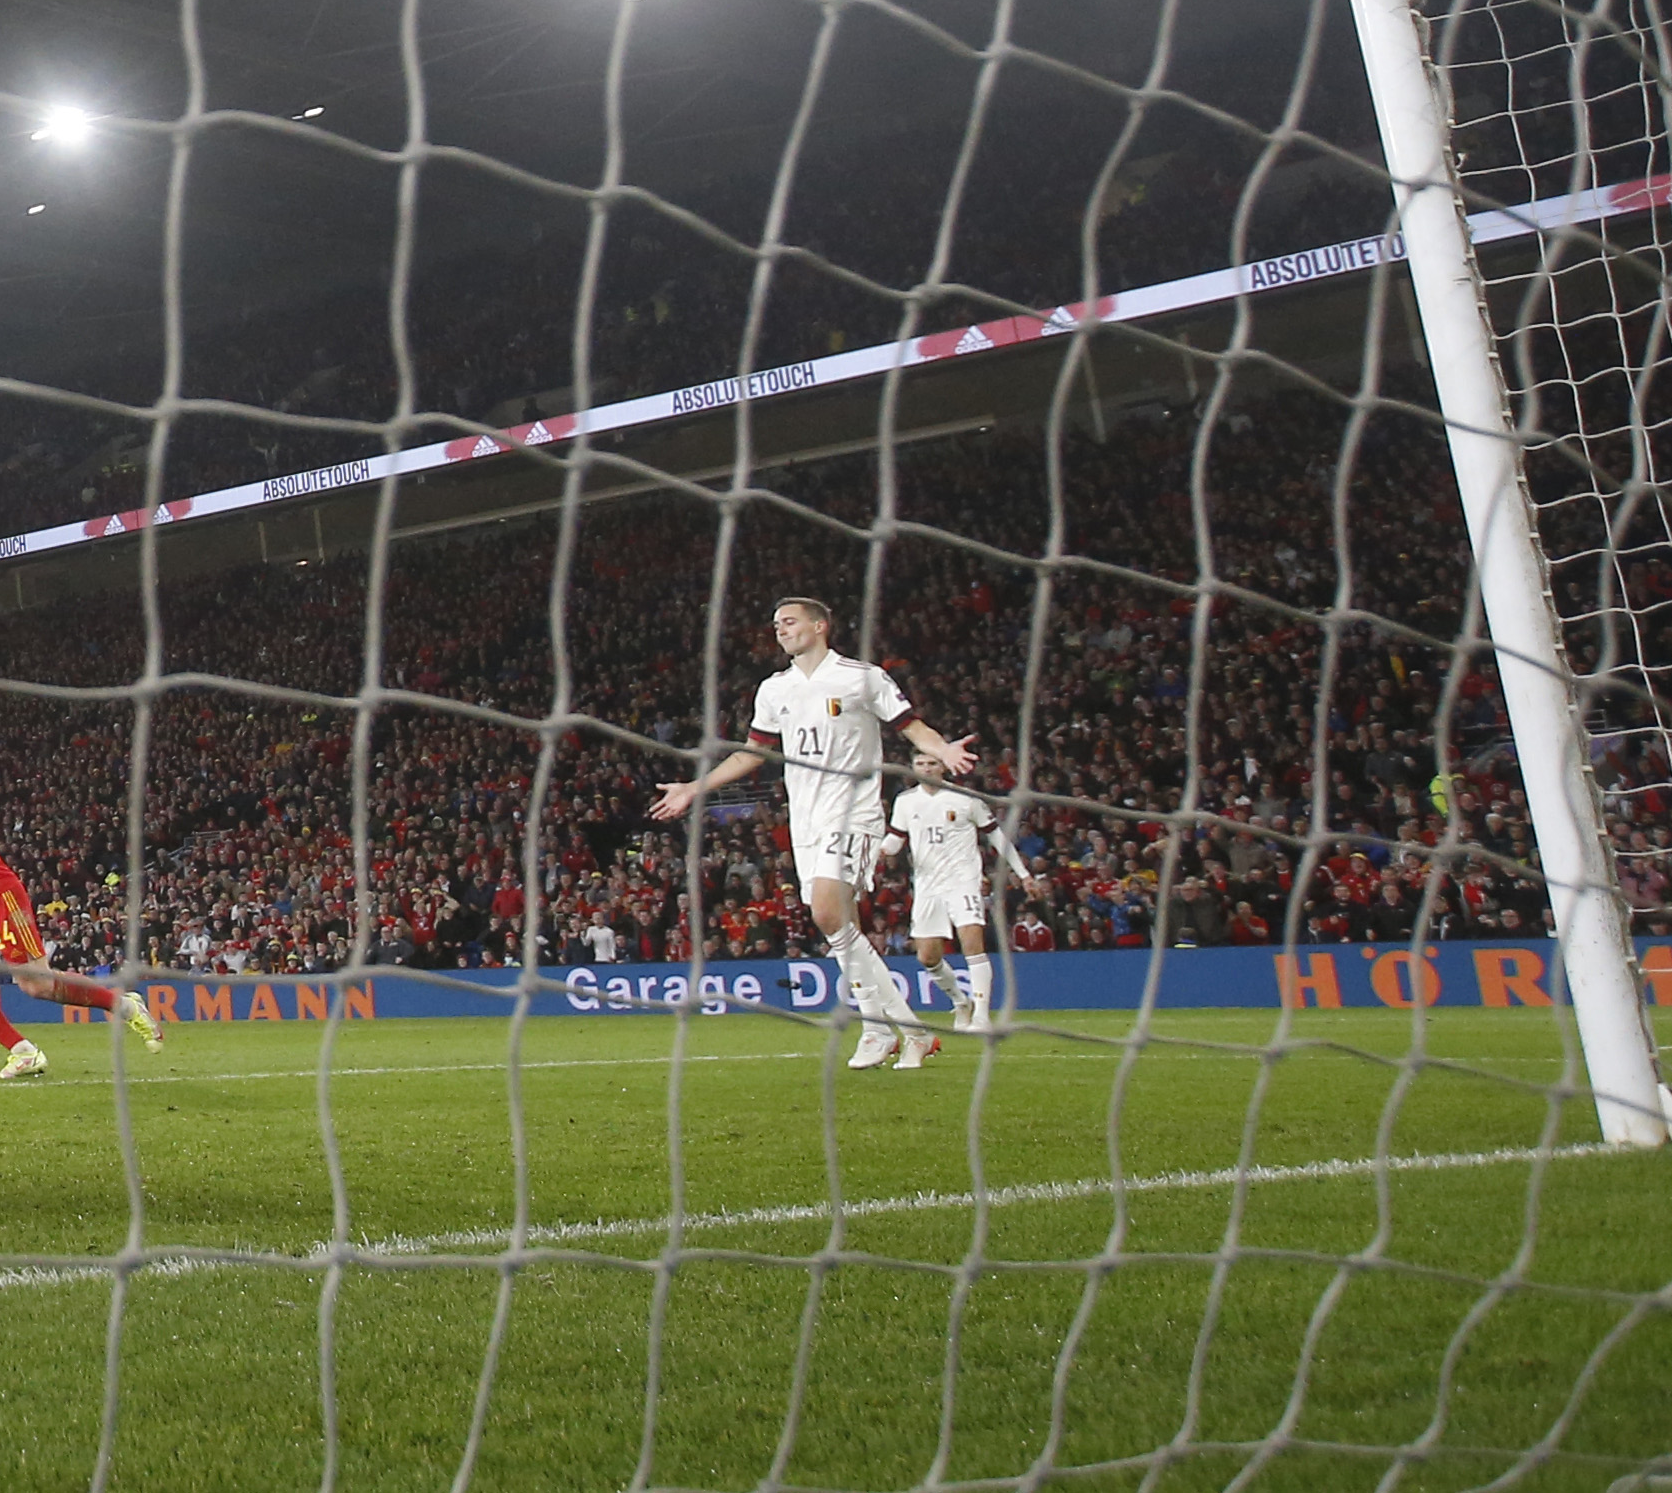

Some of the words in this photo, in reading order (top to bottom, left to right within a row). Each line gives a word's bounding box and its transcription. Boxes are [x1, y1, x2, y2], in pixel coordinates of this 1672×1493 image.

[1251, 234, 1408, 289] ABSOLUTETO
[262, 459, 371, 500] ABSOLUTETOUCH
[796, 727, 824, 755] 21
[826, 832, 855, 858] 21
[927, 827, 944, 844] 15
[565, 966, 763, 1015] Garage
[788, 962, 972, 1006] Drs
